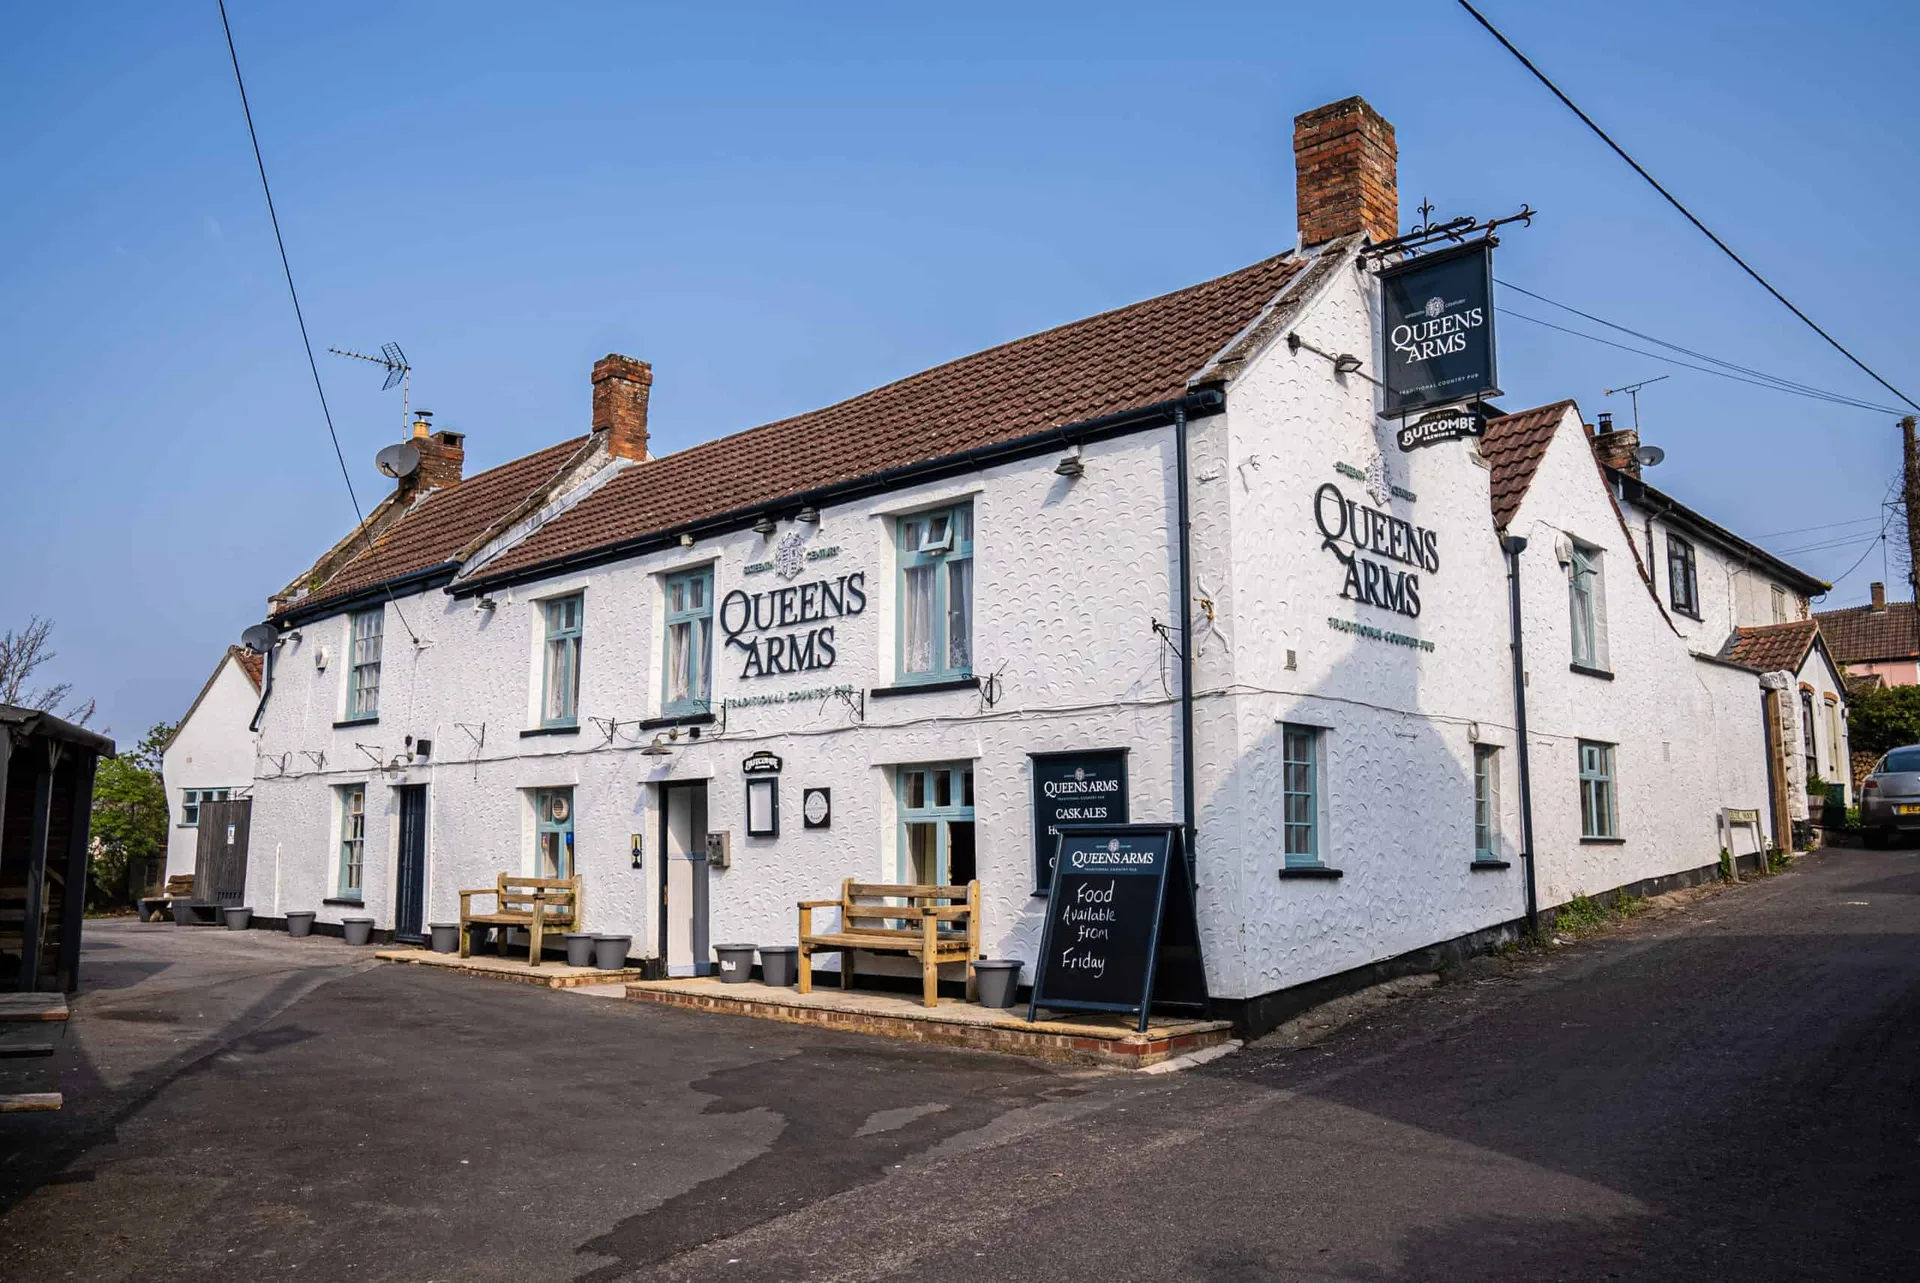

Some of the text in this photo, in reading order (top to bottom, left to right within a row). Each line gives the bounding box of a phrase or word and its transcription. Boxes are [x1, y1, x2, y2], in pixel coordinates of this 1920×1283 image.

[1391, 307, 1483, 353] QUEENS
[1406, 332, 1467, 365] ARMS
[1399, 372, 1479, 395] TRADITIONAL COUNTRY PUB
[1402, 416, 1477, 446] BUTCOMBE
[1314, 482, 1439, 574] QUEENS
[1338, 550, 1421, 618] ARMS
[720, 571, 868, 650] QUEENS
[739, 625, 837, 679] ARMS
[1044, 780, 1119, 798] QUEENS ARMS
[1055, 807, 1108, 820] CASK ALES
[1072, 850, 1121, 868] QUEENS
[1120, 852, 1154, 864] ARMS
[1077, 879, 1115, 904] Food
[1063, 905, 1117, 925] Available
[1077, 924, 1108, 942] from
[1062, 946, 1105, 978] Friday
